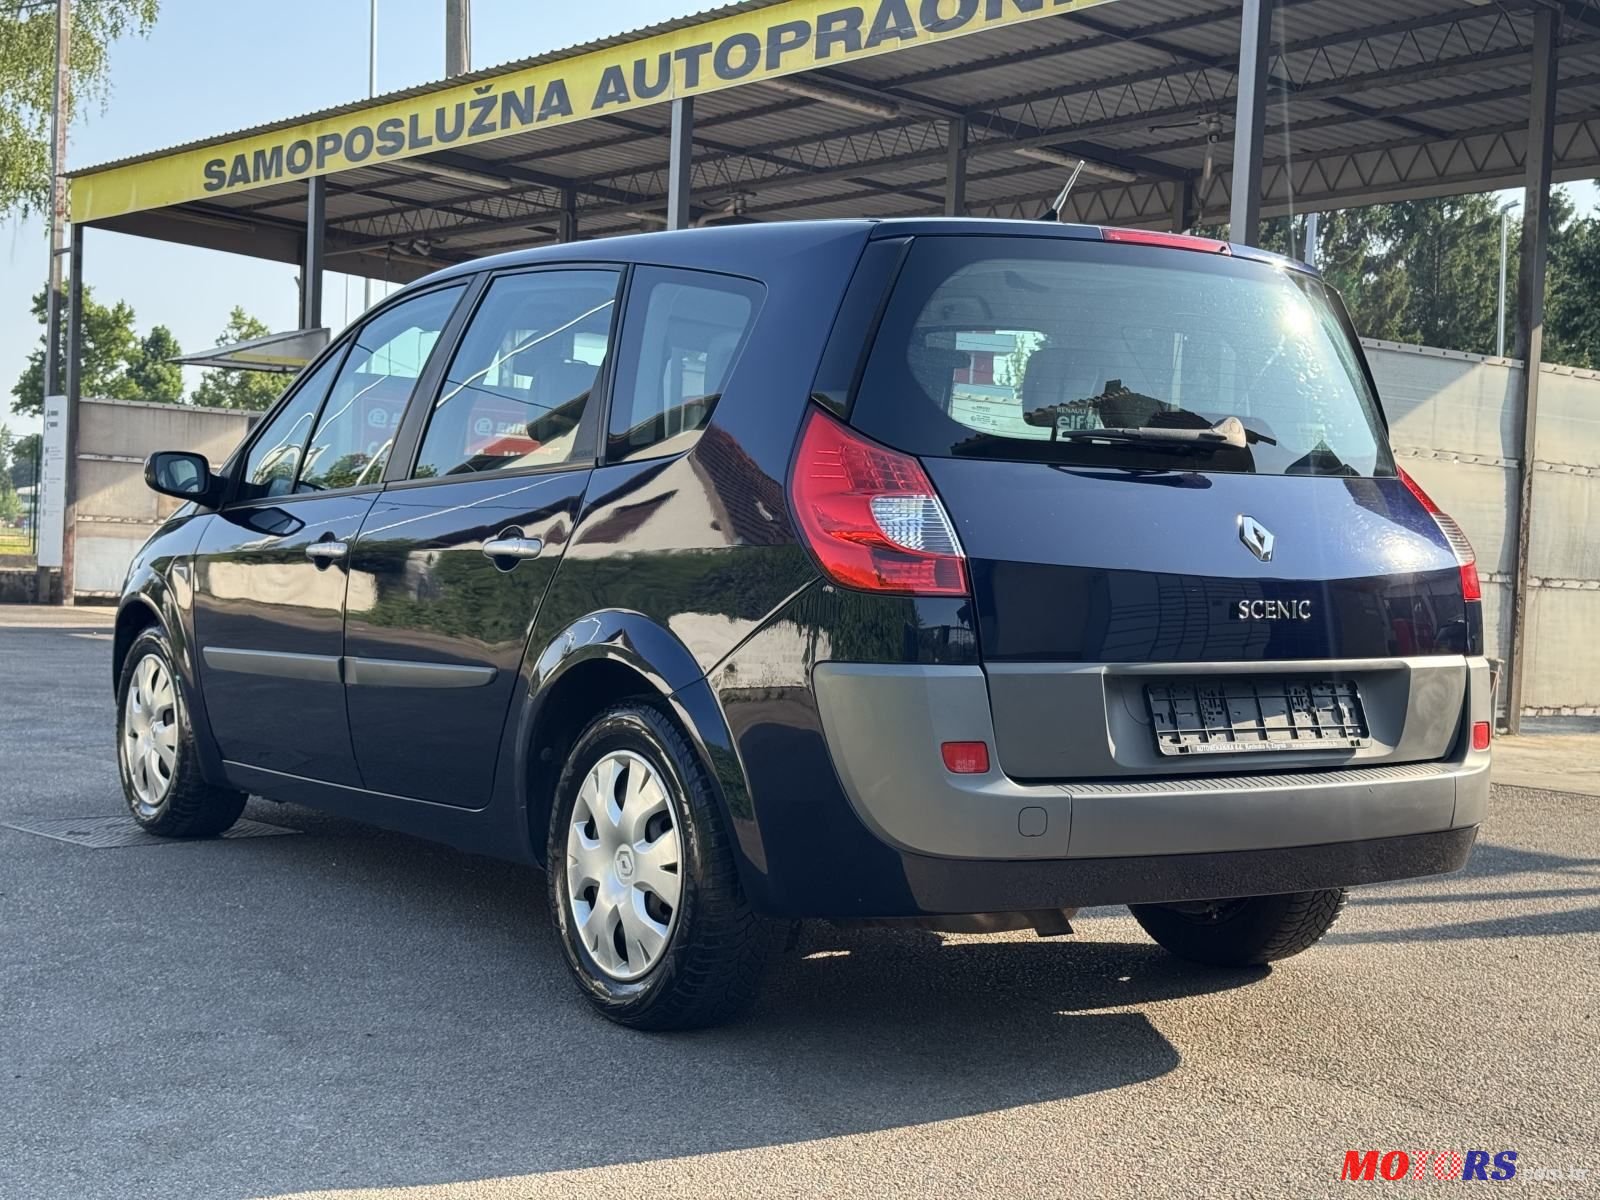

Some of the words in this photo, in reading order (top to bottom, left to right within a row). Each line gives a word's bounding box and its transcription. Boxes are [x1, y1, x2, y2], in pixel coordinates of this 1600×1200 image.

[203, 84, 573, 192] SAMOPOSLUŽNA
[1056, 414, 1086, 430] elf
[1238, 599, 1312, 619] SCENIC
